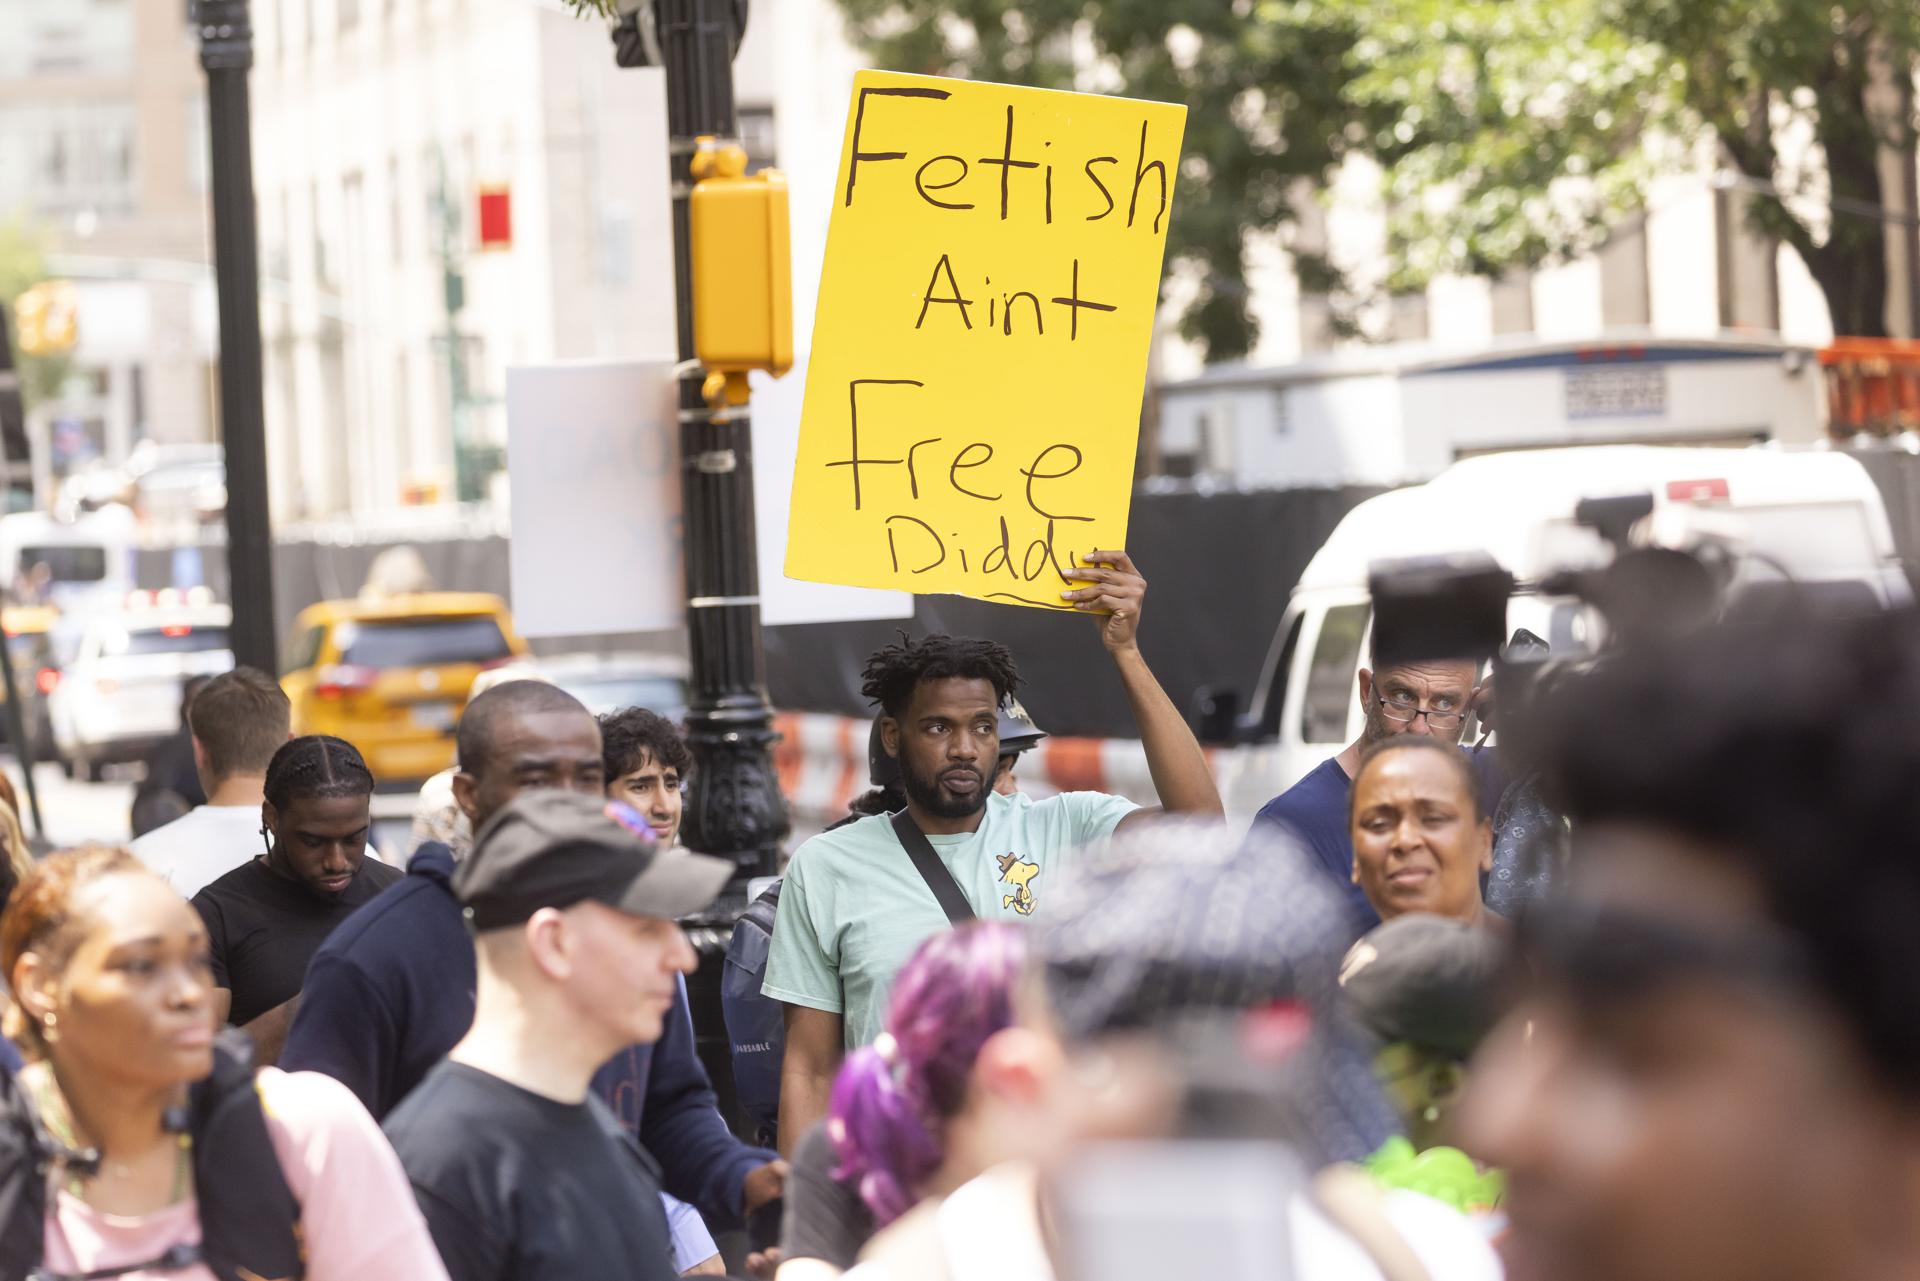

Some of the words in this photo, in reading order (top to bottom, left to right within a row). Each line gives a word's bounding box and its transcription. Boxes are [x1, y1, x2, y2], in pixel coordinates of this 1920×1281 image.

[846, 88, 1167, 235] Fetish
[915, 254, 1117, 341] Aint
[826, 380, 1096, 521] Free
